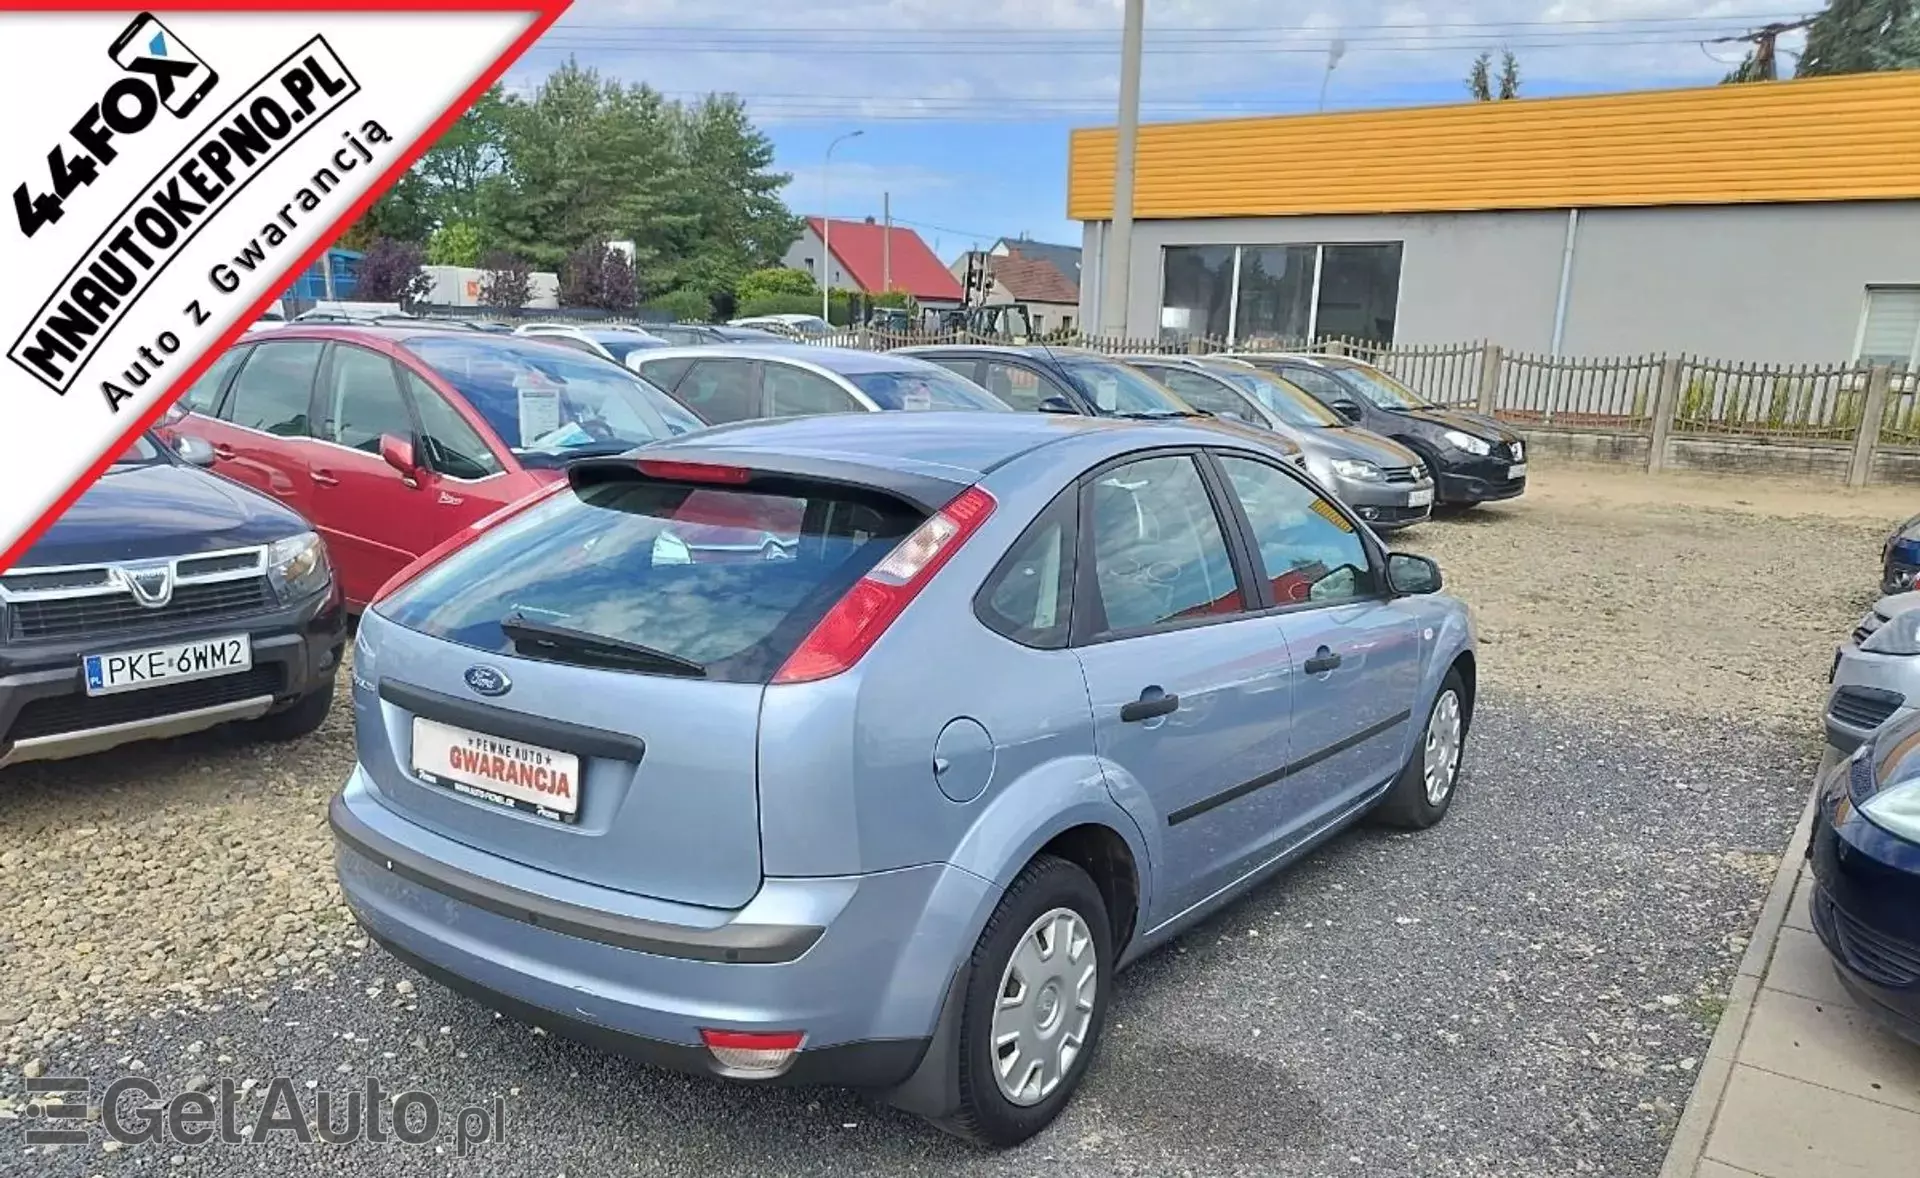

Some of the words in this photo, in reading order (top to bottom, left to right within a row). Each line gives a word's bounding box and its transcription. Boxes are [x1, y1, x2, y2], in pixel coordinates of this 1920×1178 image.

[108, 651, 165, 684] PKE
[177, 640, 242, 673] 6WM2
[90, 677, 102, 685] PL
[476, 738, 511, 757] PEWNE
[515, 747, 542, 765] AUTO
[449, 745, 570, 798] GWARANCJA
